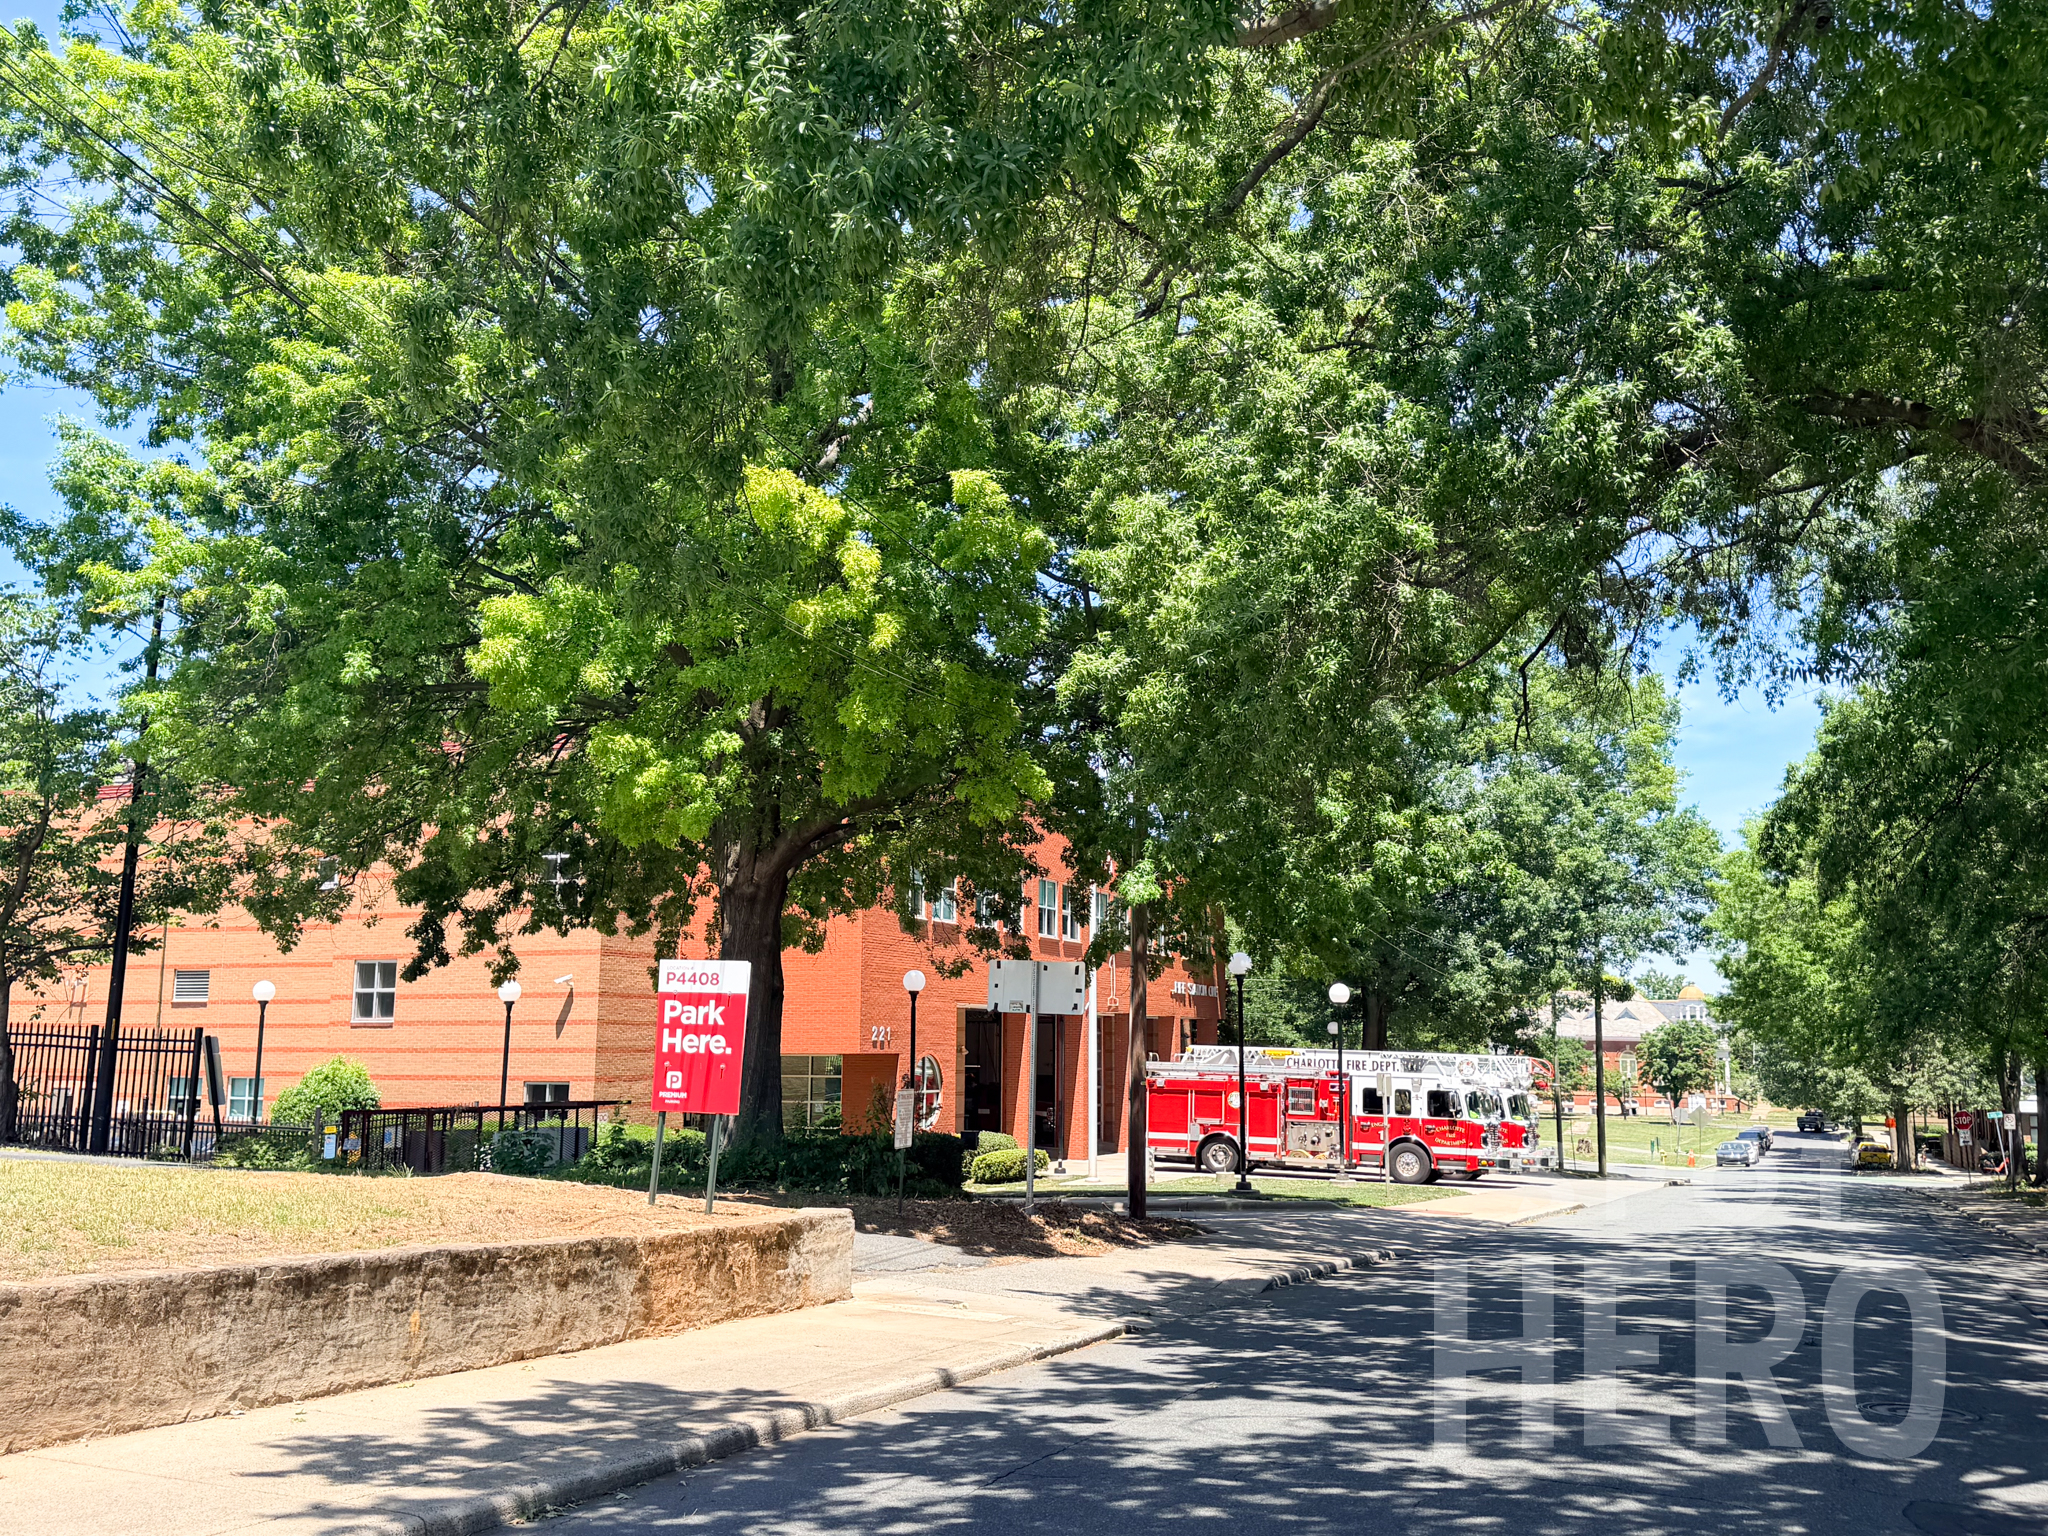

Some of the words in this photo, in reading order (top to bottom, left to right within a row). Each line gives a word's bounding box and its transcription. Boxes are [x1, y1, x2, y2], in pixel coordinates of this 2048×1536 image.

[666, 971, 720, 986] P4408
[663, 1000, 725, 1026] Park
[871, 1025, 891, 1041] 221
[662, 1028, 732, 1055] Here.
[1346, 1059, 1367, 1071] FIRE
[1372, 1060, 1400, 1072] DEPT.
[658, 1091, 688, 1099] PREMIUM
[1954, 1116, 1972, 1125] STOP
